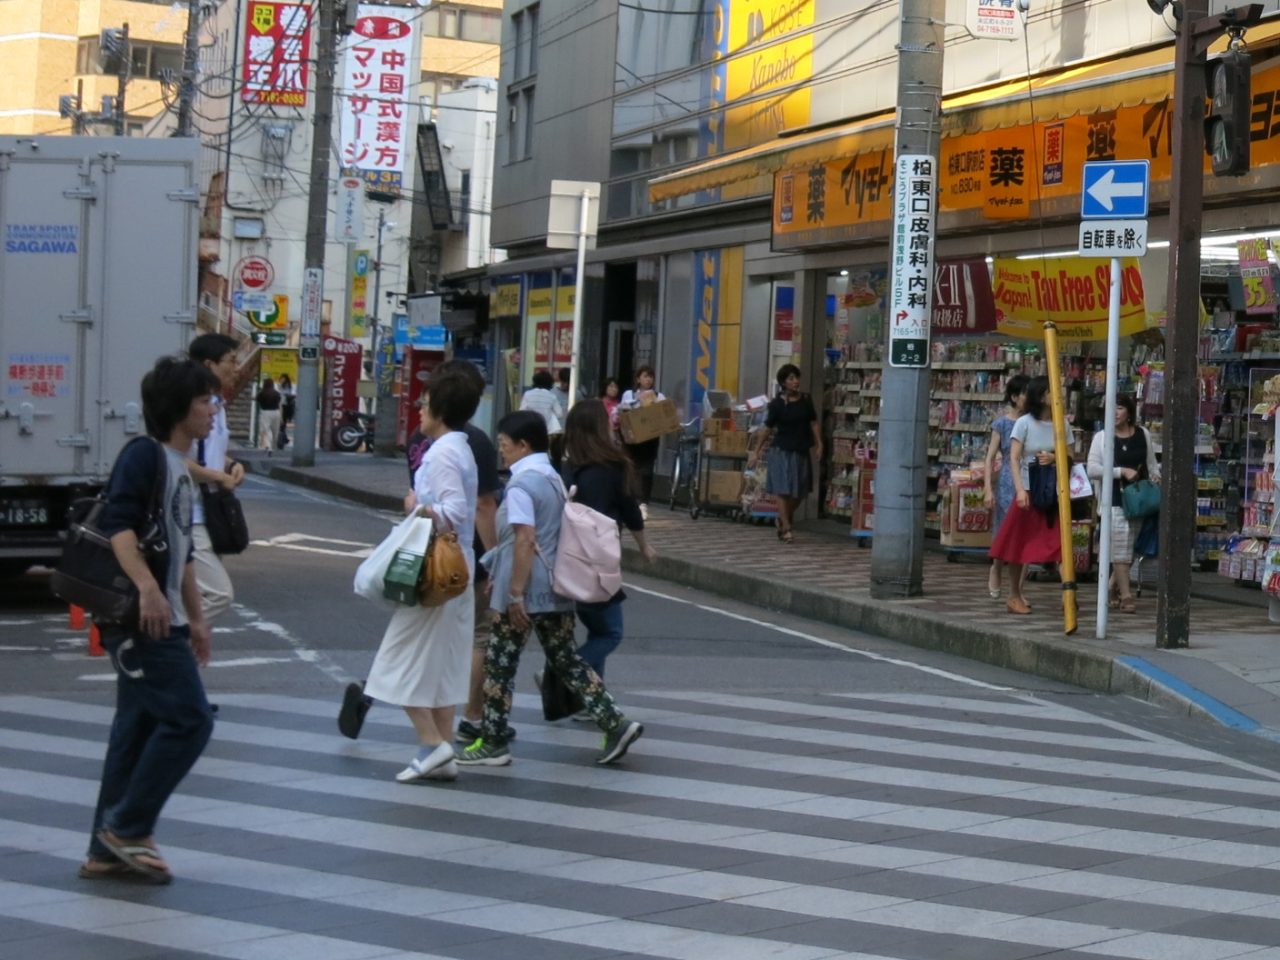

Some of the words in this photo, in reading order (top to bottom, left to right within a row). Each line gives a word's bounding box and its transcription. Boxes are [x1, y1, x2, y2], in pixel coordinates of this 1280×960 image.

[345, 45, 375, 166] マッサージ
[374, 48, 407, 168] 中国式漢方
[1046, 129, 1060, 162] 薬
[990, 147, 1025, 187] 薬
[807, 164, 827, 224] 薬
[6, 240, 78, 254] SAGAWA
[908, 159, 933, 310] 柏東口皮膚科・内科
[1083, 228, 1144, 250] 自転車を除く
[1031, 270, 1058, 313] Tax
[1059, 269, 1095, 312] Free
[911, 319, 928, 328] 入口
[901, 353, 920, 363] 2-2
[331, 355, 346, 427] コインロッカー
